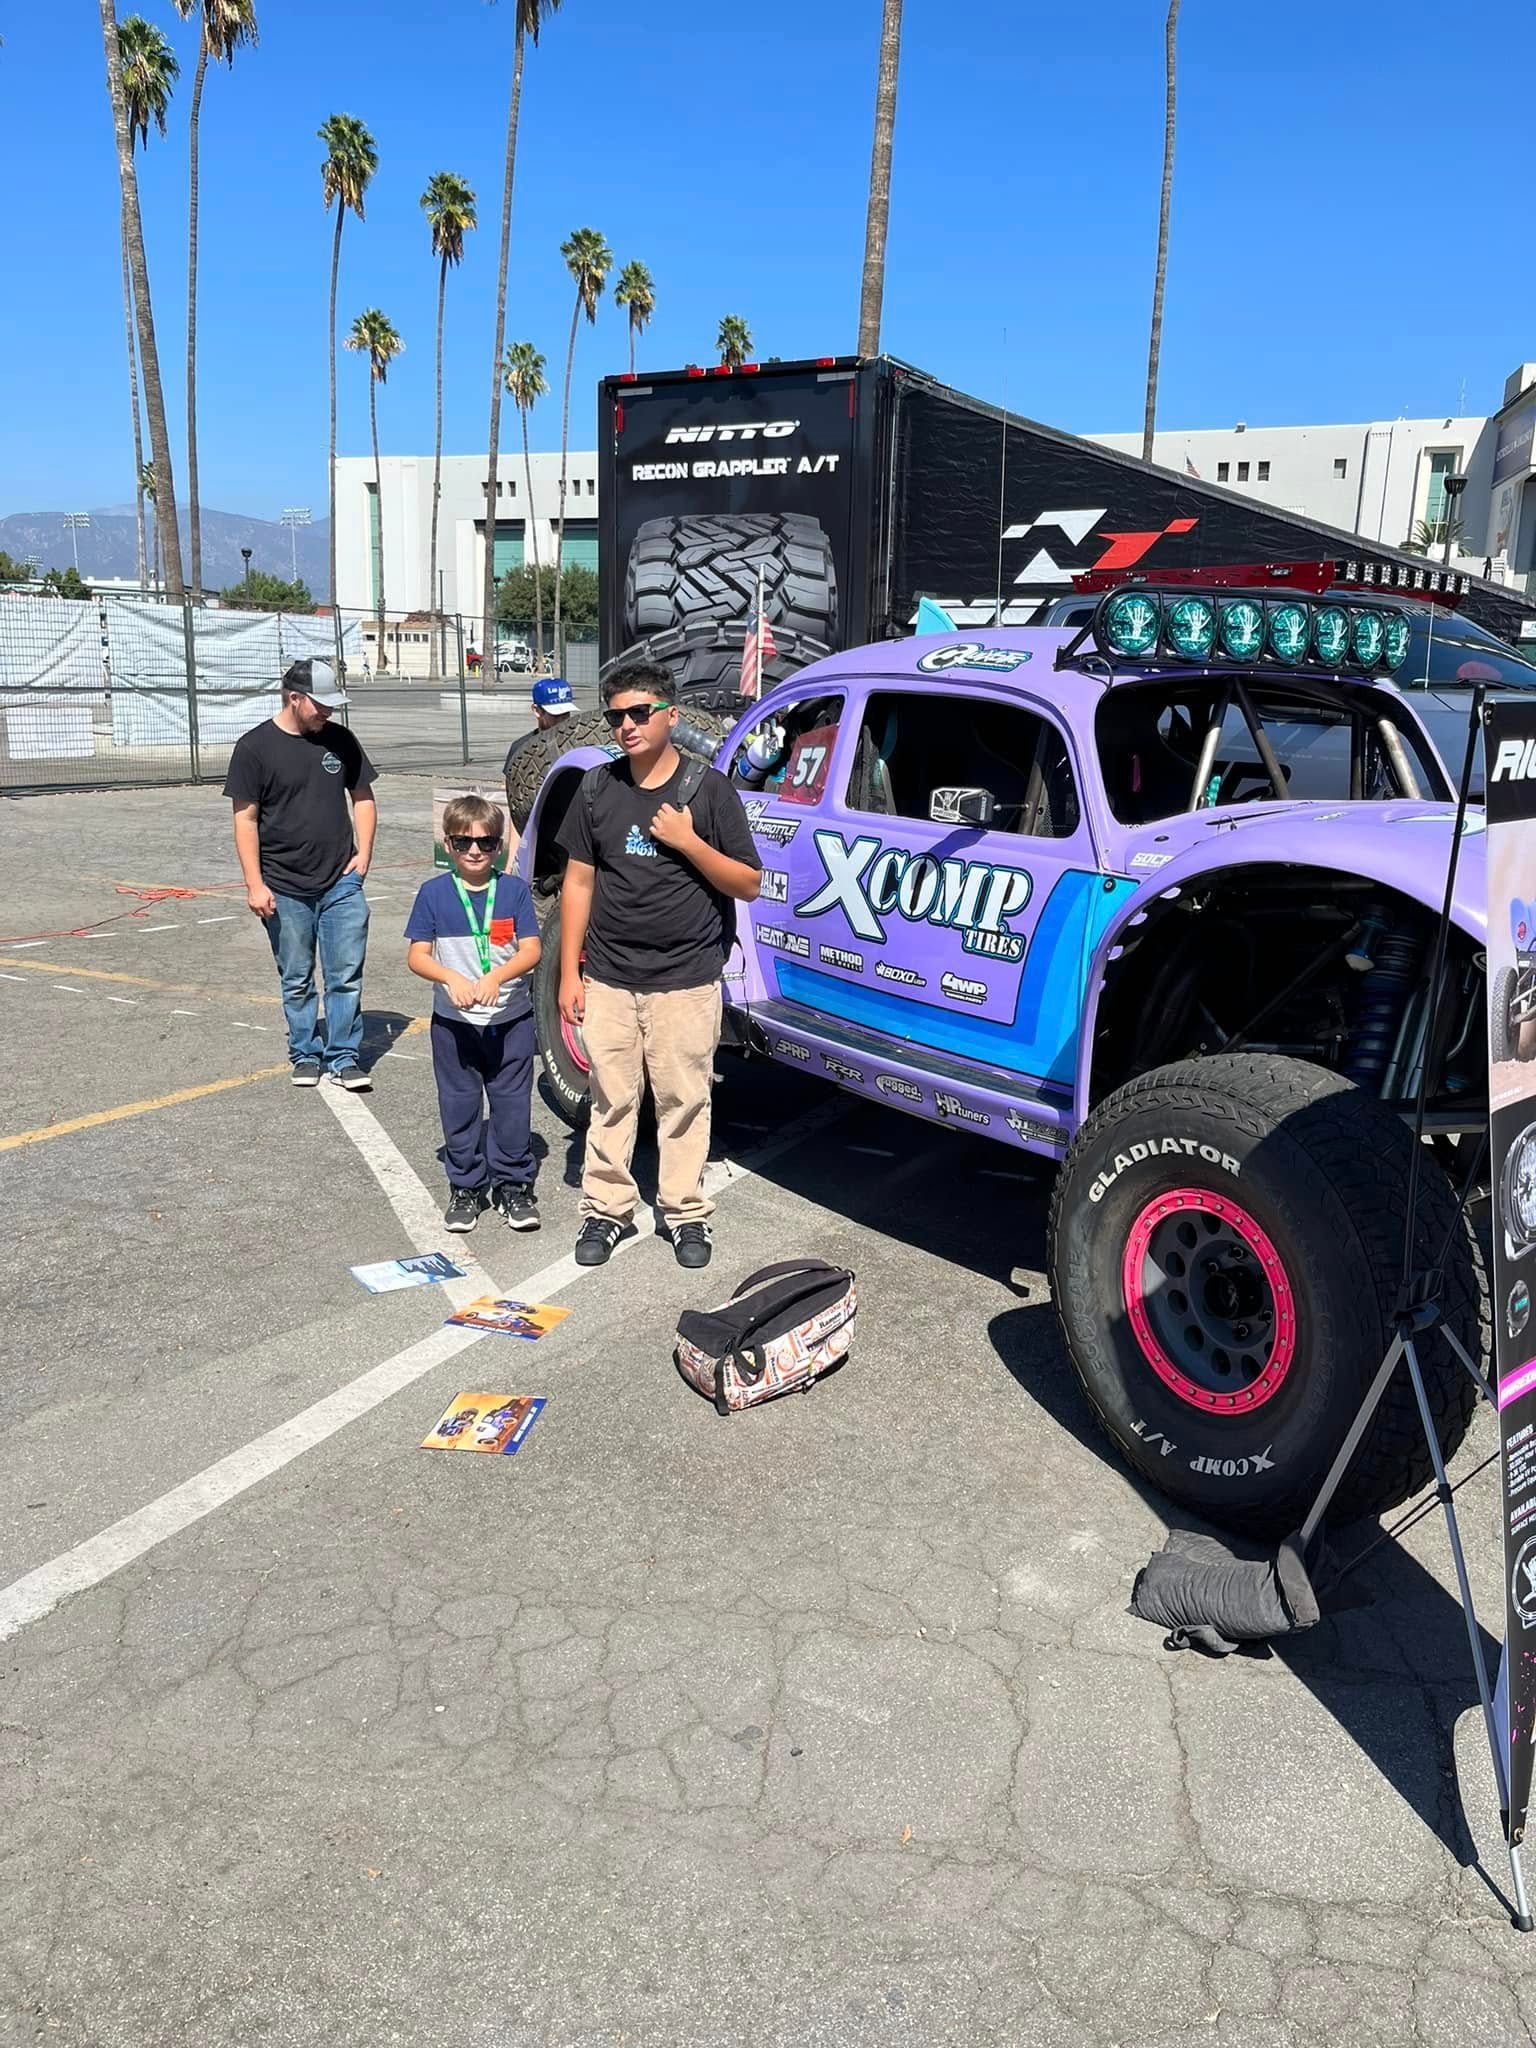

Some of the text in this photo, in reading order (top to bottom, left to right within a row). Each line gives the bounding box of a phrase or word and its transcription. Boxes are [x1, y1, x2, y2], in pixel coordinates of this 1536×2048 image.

[665, 420, 799, 444] NITTO
[632, 455, 840, 481] RECON GRAPPLER A/T
[792, 746, 827, 787] 57
[795, 830, 1031, 941] XCOMP
[820, 945, 863, 965] METHOD
[965, 928, 1022, 957] TIRES
[1088, 1137, 1241, 1203] GLADIATOR
[1130, 1419, 1276, 1477] XCOMP A/T
